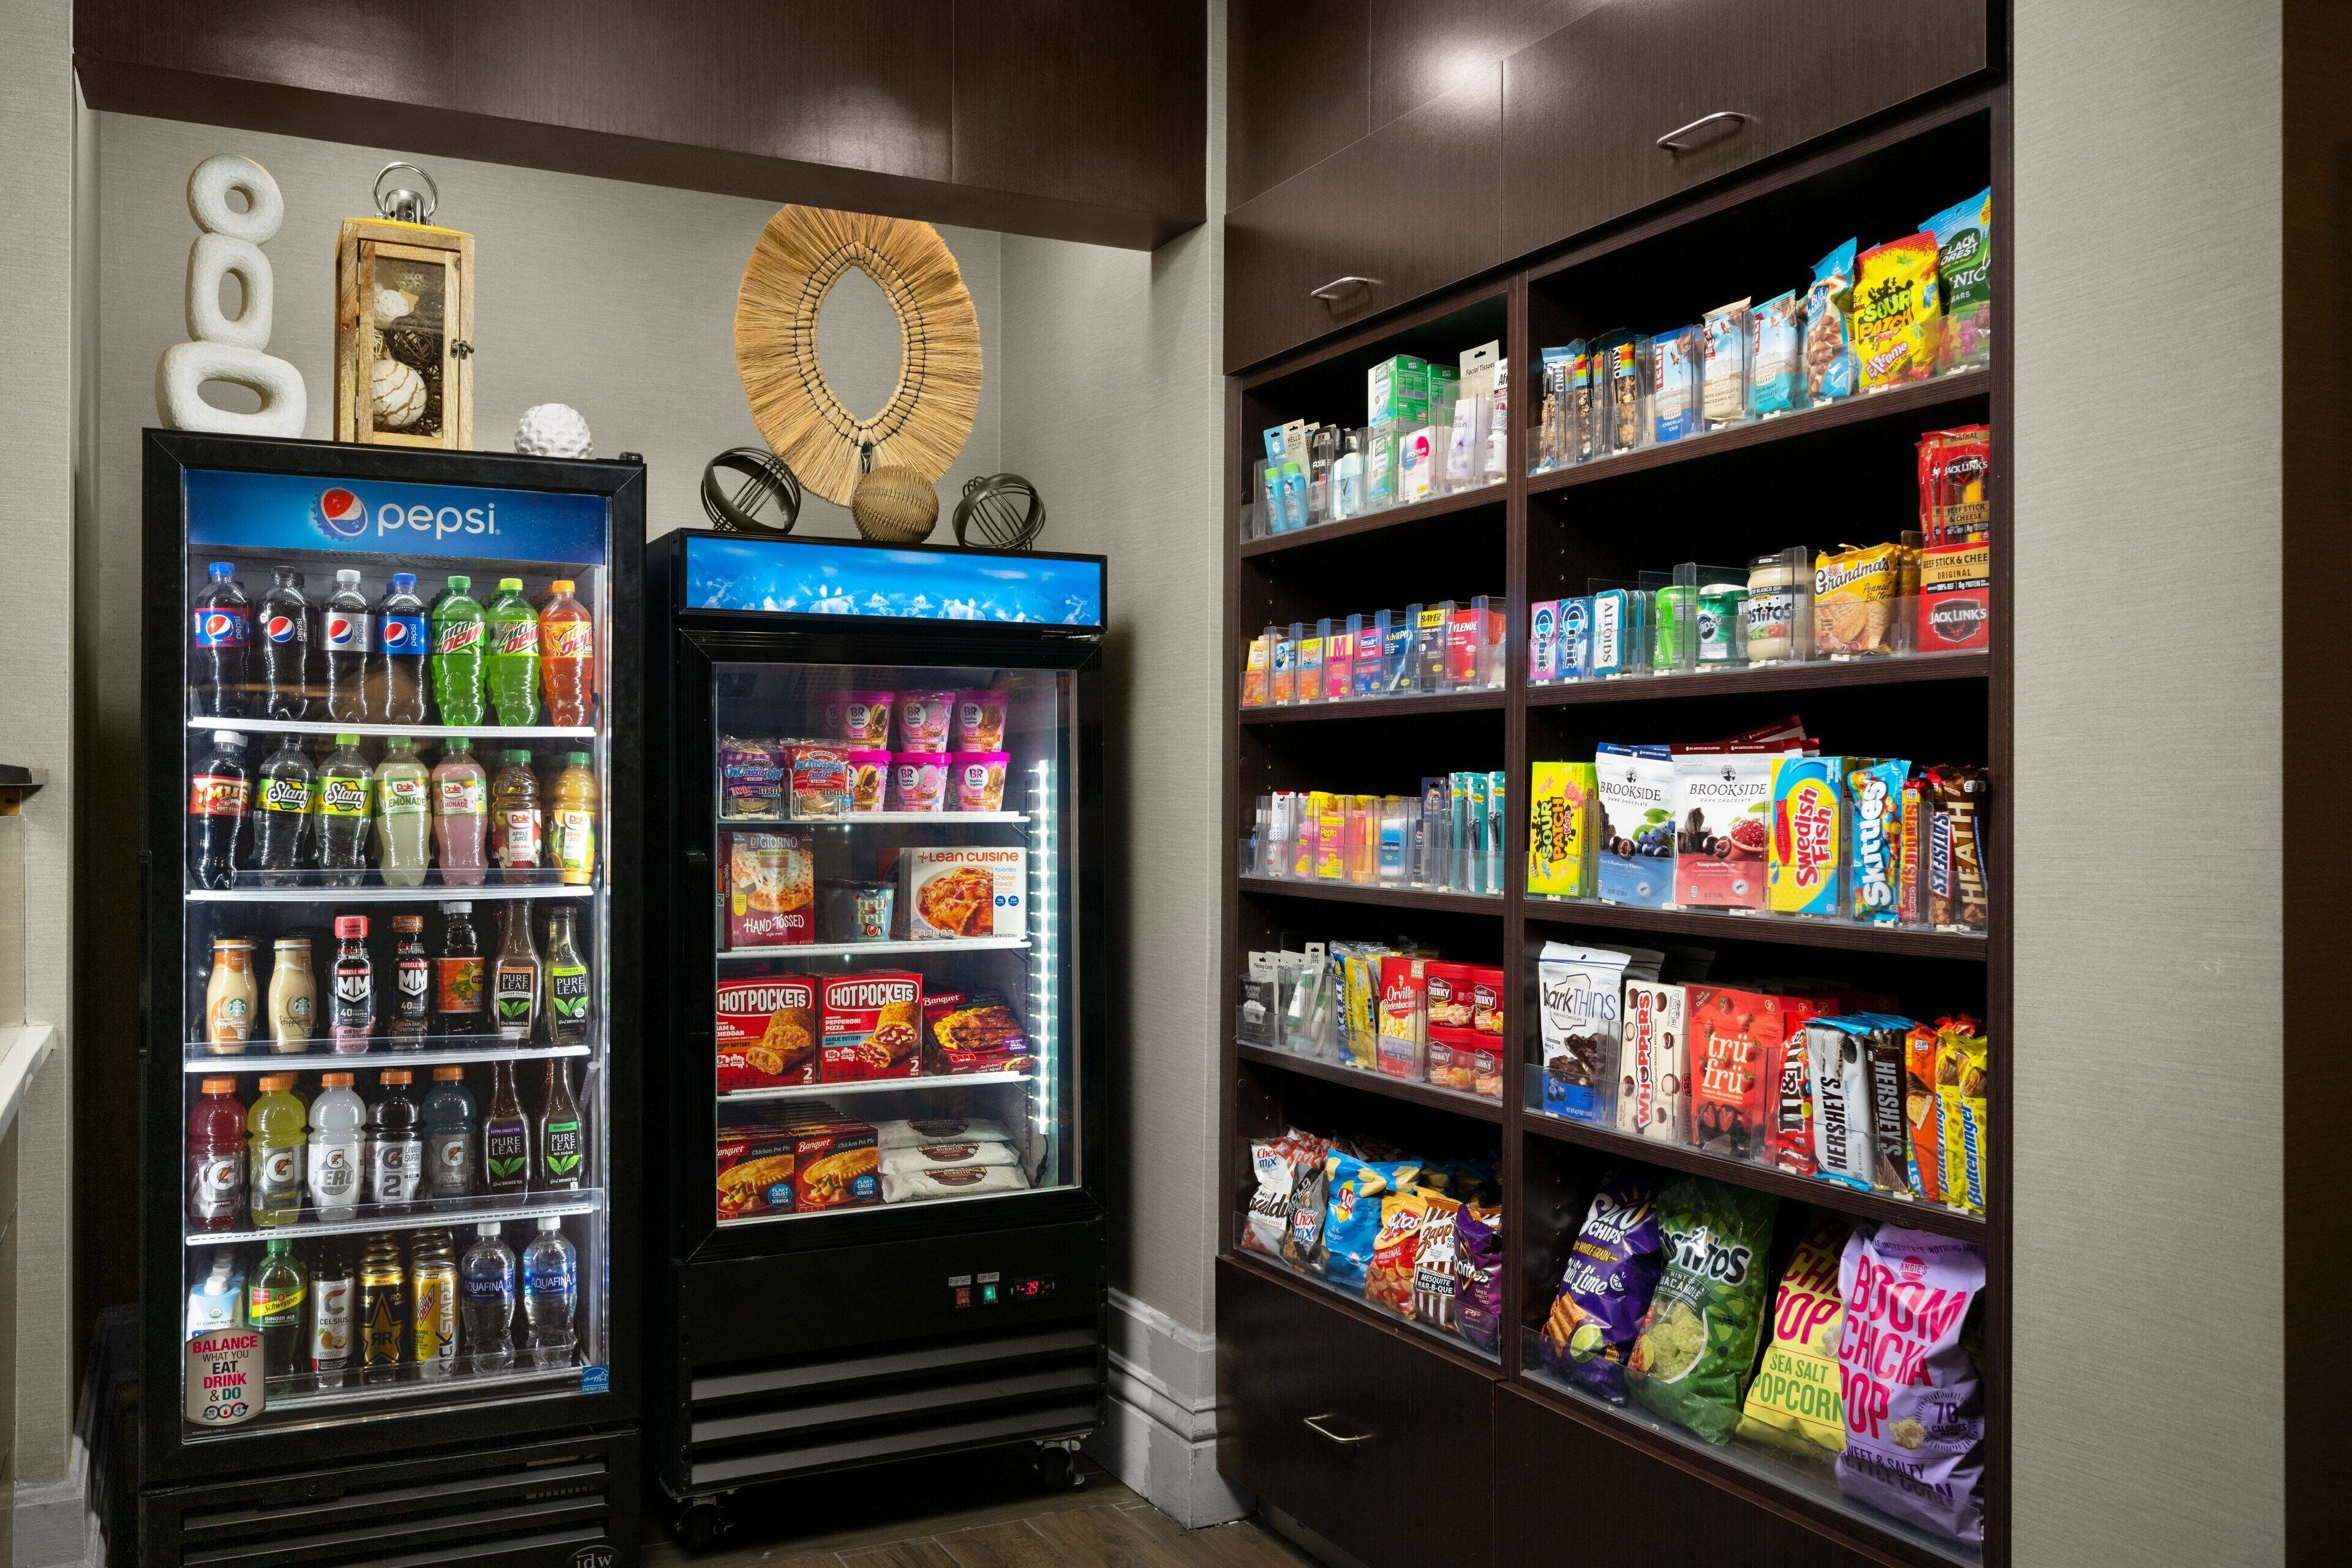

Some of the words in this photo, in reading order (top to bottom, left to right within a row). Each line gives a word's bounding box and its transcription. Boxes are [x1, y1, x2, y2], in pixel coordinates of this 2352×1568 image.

[1864, 289, 1913, 322] SOUR
[1858, 307, 1914, 338] PATCH
[1466, 366, 1479, 375] Facial
[1480, 362, 1495, 372] Tissues
[1662, 418, 1684, 428] CHOCOLATE
[1287, 434, 1301, 443] HELLO
[1950, 432, 1978, 443] ORIGINAL
[1943, 464, 1961, 476] JACK
[1962, 459, 1988, 472] LINK'S
[1947, 505, 1962, 515] BEEF
[1963, 503, 1985, 513] STICK
[1956, 513, 1983, 522] CHEESE
[378, 503, 496, 540] pepsi
[1815, 557, 1890, 595] Grandma's
[1937, 568, 1971, 580] ORIGINAL
[1863, 581, 1892, 593] Peanut
[1865, 592, 1893, 603] Butter
[1422, 613, 1441, 623] BAYER
[1929, 610, 1952, 625] JACK
[1953, 607, 1987, 622] LINK'S
[1448, 622, 1477, 634] TYLENOL
[1603, 603, 1613, 662] ALTOIDS
[1385, 633, 1400, 641] Advil
[851, 707, 863, 717] BR
[908, 707, 920, 716] BR
[269, 781, 310, 809] Starry
[325, 780, 366, 810] Starry
[1600, 782, 1661, 802] BROOKSIDE
[1689, 783, 1767, 797] BROOKSIDE
[385, 797, 425, 808] LEMONADE
[439, 799, 468, 809] LEMONADE
[1321, 827, 1336, 837] Pepto
[1540, 801, 1553, 858] SOUR
[1552, 796, 1566, 862] PATCH
[1794, 786, 1819, 888] Swedish
[1811, 806, 1833, 865] Fish
[1860, 780, 1892, 907] Skittles
[1947, 802, 1986, 905] HEATH
[557, 976, 585, 986] PURE
[719, 990, 747, 1012] HOT
[831, 986, 858, 1006] HOT
[922, 995, 960, 1006] Banquet
[1387, 986, 1412, 1000] Orville
[1707, 1031, 1747, 1063] trü
[1638, 991, 1653, 1128] WHOPPERS
[804, 1067, 813, 1080] 2
[1702, 1058, 1744, 1095] frü
[1874, 1060, 1902, 1156] HERSHEY'S
[1820, 1076, 1847, 1170] HERSHEY'S
[491, 1136, 521, 1147] PURE
[551, 1133, 575, 1143] PURE
[799, 1139, 832, 1152] Banquet
[442, 1140, 464, 1167] G
[1257, 1148, 1278, 1159] Chex
[1961, 1101, 1984, 1207] Butterfinger
[266, 1152, 294, 1182] G
[1259, 1156, 1277, 1169] mix
[313, 1169, 353, 1186] ZERO
[383, 1175, 402, 1197] 2
[1294, 1209, 1318, 1226] Chex
[1294, 1225, 1315, 1244] mix
[1588, 1221, 1625, 1245] CHIPS
[1378, 1248, 1401, 1260] ORIGINAL
[1579, 1242, 1594, 1256] WHOLE
[1594, 1247, 1611, 1262] GRAIN
[1899, 1262, 1928, 1275] ANGIE'S
[464, 1280, 503, 1293] AQUAFINA
[531, 1276, 571, 1289] AQUAFINA
[1421, 1275, 1450, 1287] MESQUITE
[1572, 1267, 1608, 1296] Lime
[264, 1295, 298, 1313] Schweppes
[1849, 1254, 1967, 1343] BOOM
[319, 1317, 349, 1325] CELSIUS
[1776, 1286, 1841, 1345] POP
[435, 1281, 454, 1376] KICKSTART
[193, 1336, 258, 1354] BALANCE
[202, 1352, 228, 1362] WHAT
[232, 1349, 249, 1359] YOU
[1770, 1353, 1793, 1374] SEA
[1795, 1357, 1829, 1384] SALT
[203, 1373, 247, 1389] DRINK
[210, 1390, 219, 1401] &
[222, 1387, 241, 1400] DO
[1751, 1374, 1845, 1424] POPCORN
[1839, 1364, 1891, 1440] POP
[1932, 1401, 1959, 1425] 70
[1931, 1423, 1967, 1433] CALORIES
[1876, 1454, 1885, 1468] &
[1887, 1458, 1924, 1479] SALTY
